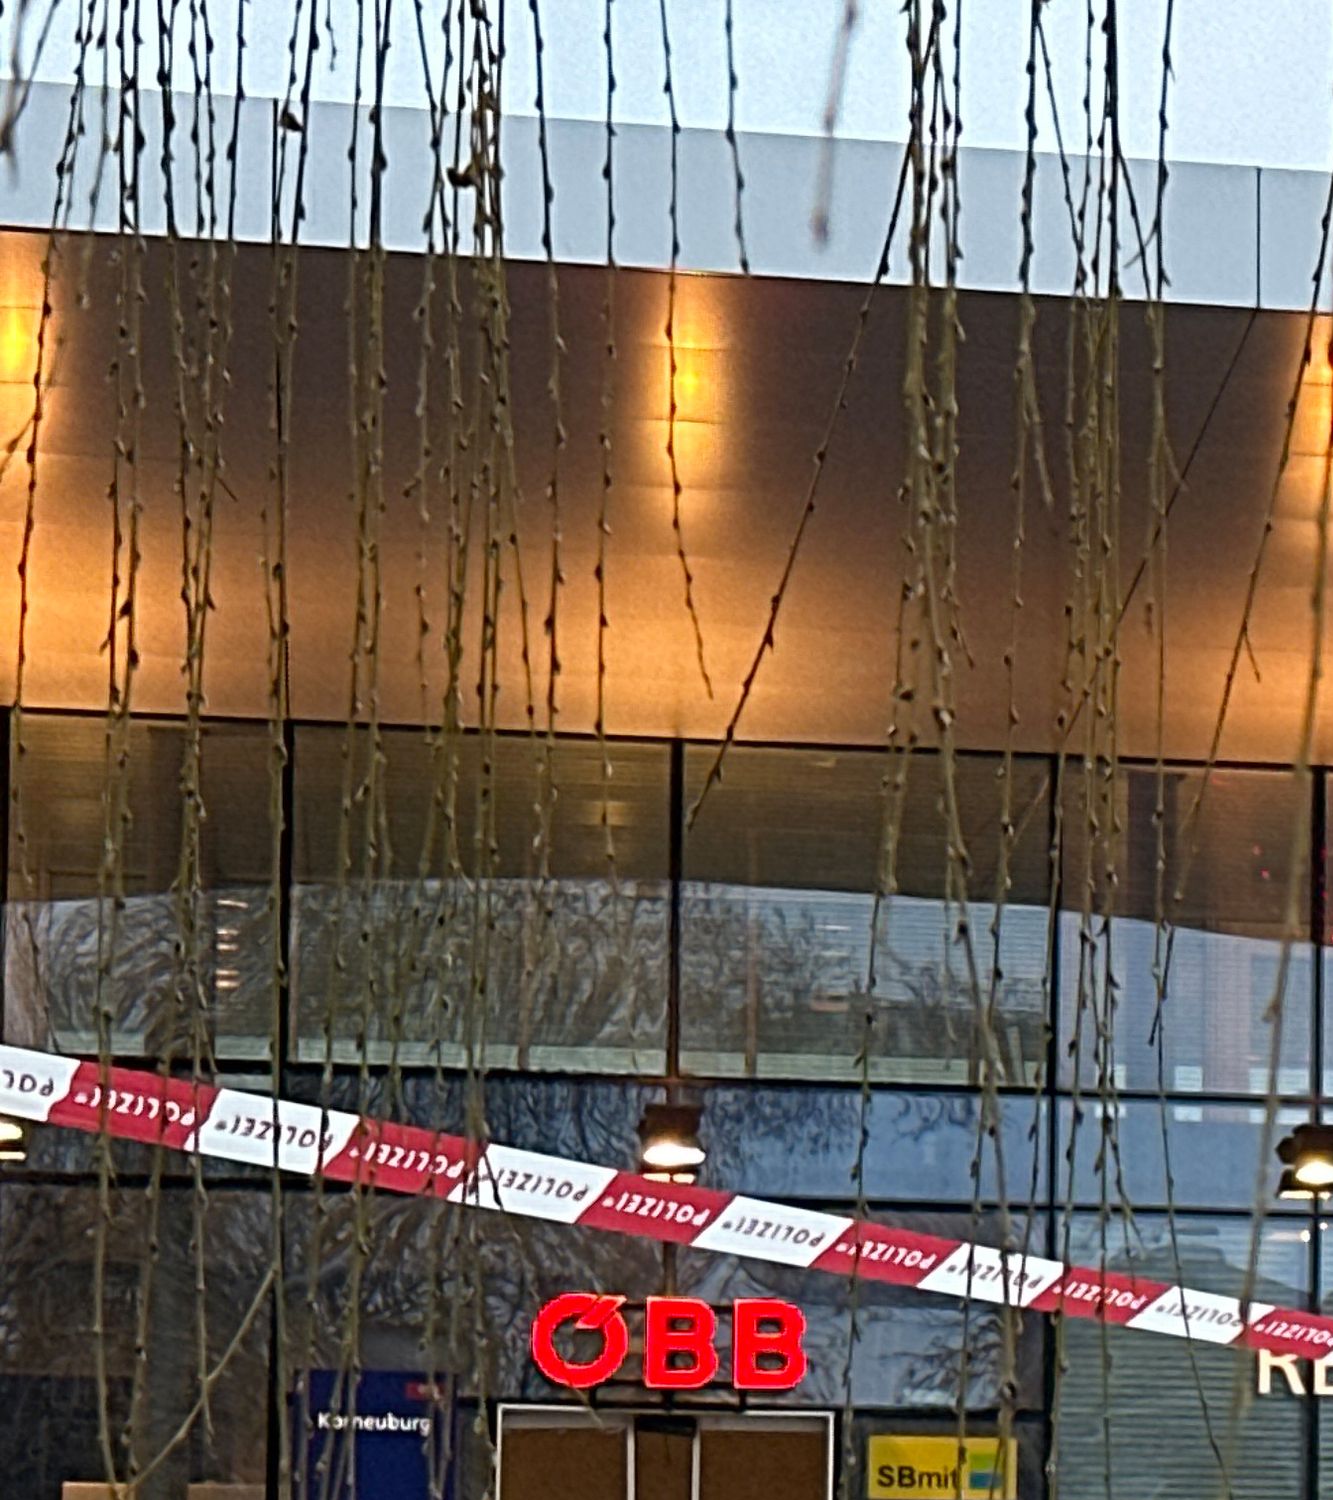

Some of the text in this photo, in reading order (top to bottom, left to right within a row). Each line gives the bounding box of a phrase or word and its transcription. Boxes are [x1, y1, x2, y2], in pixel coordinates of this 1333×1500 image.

[617, 1191, 710, 1227] POLIZEI
[736, 1216, 825, 1247] POLIZEI
[532, 1293, 808, 1389] ÖBB
